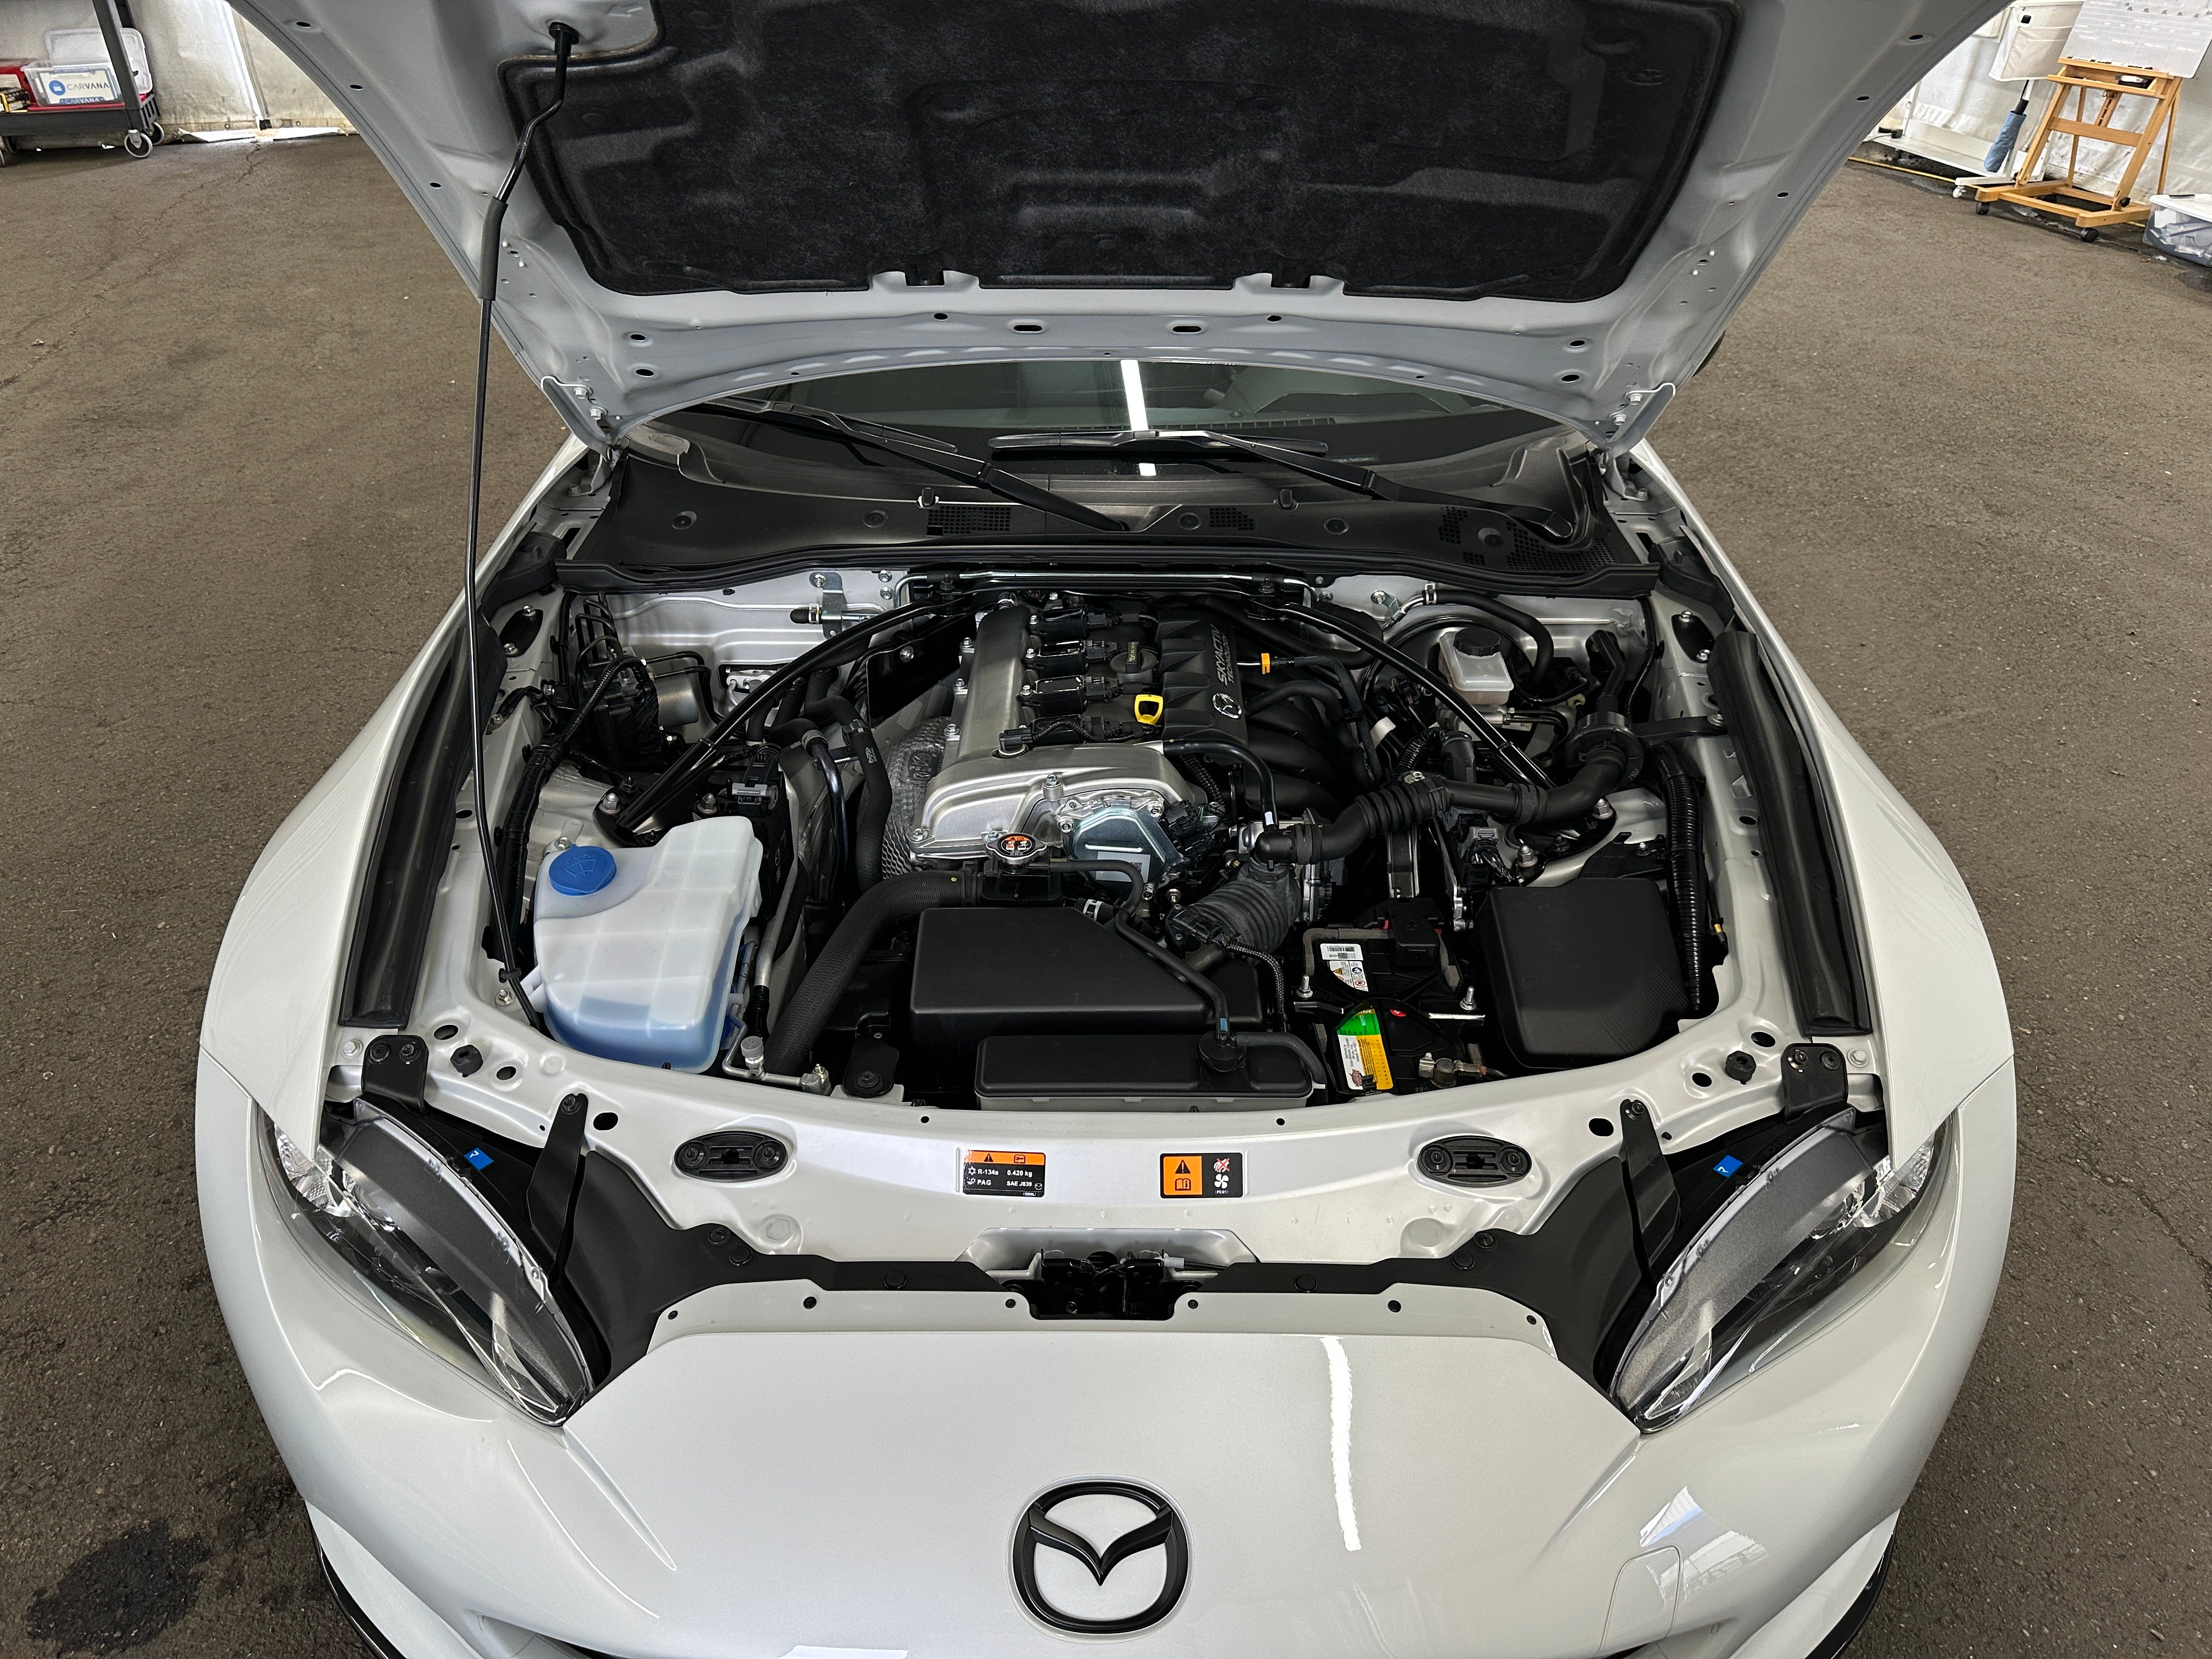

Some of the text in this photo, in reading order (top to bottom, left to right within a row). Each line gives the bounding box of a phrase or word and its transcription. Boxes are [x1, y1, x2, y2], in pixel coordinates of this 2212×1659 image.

[67, 82, 109, 91] CARVANA
[1210, 623, 1228, 687] SKYACTIV
[1221, 632, 1234, 685] TECHNOLOGY
